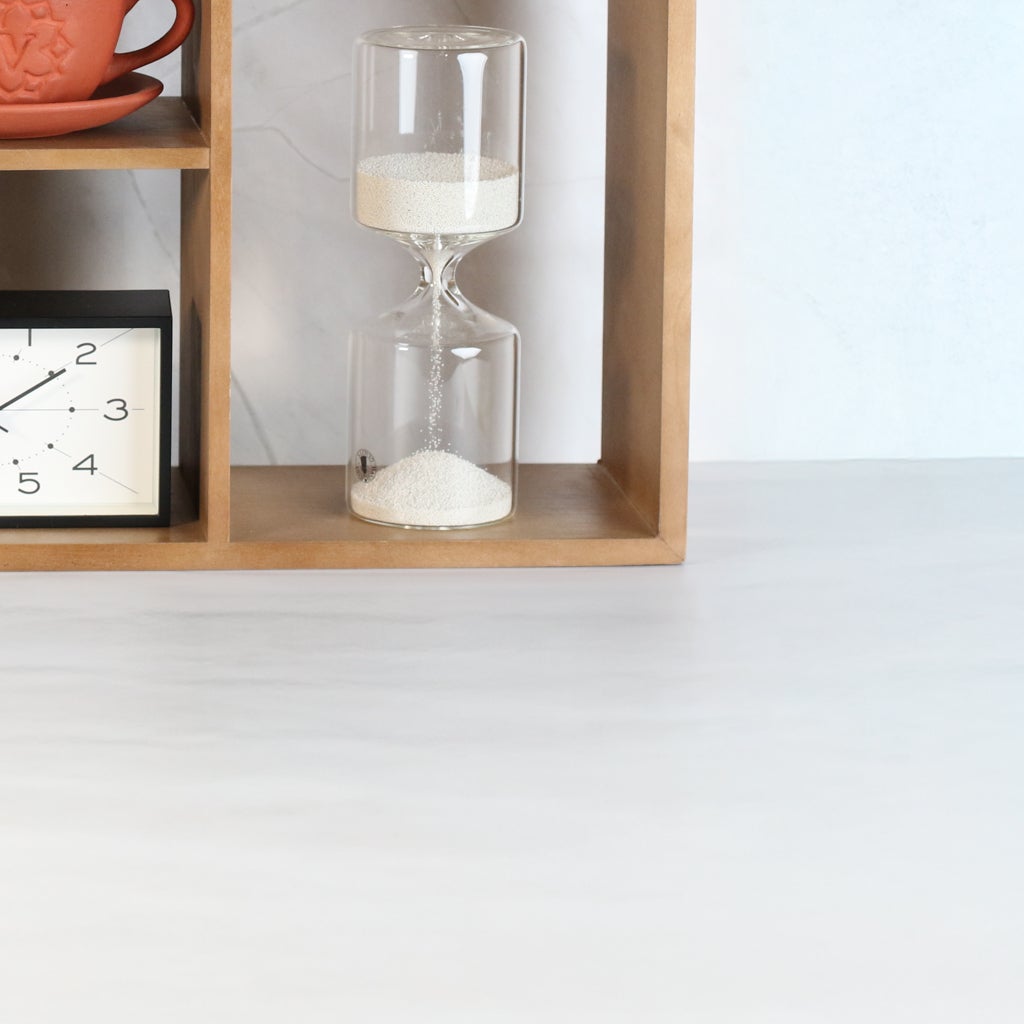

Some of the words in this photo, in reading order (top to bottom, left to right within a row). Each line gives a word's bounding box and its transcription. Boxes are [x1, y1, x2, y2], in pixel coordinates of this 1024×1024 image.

[27, 328, 33, 347] 1
[75, 342, 97, 365] 2
[103, 398, 129, 422] 3
[71, 453, 99, 476] 4
[18, 472, 41, 495] 5
